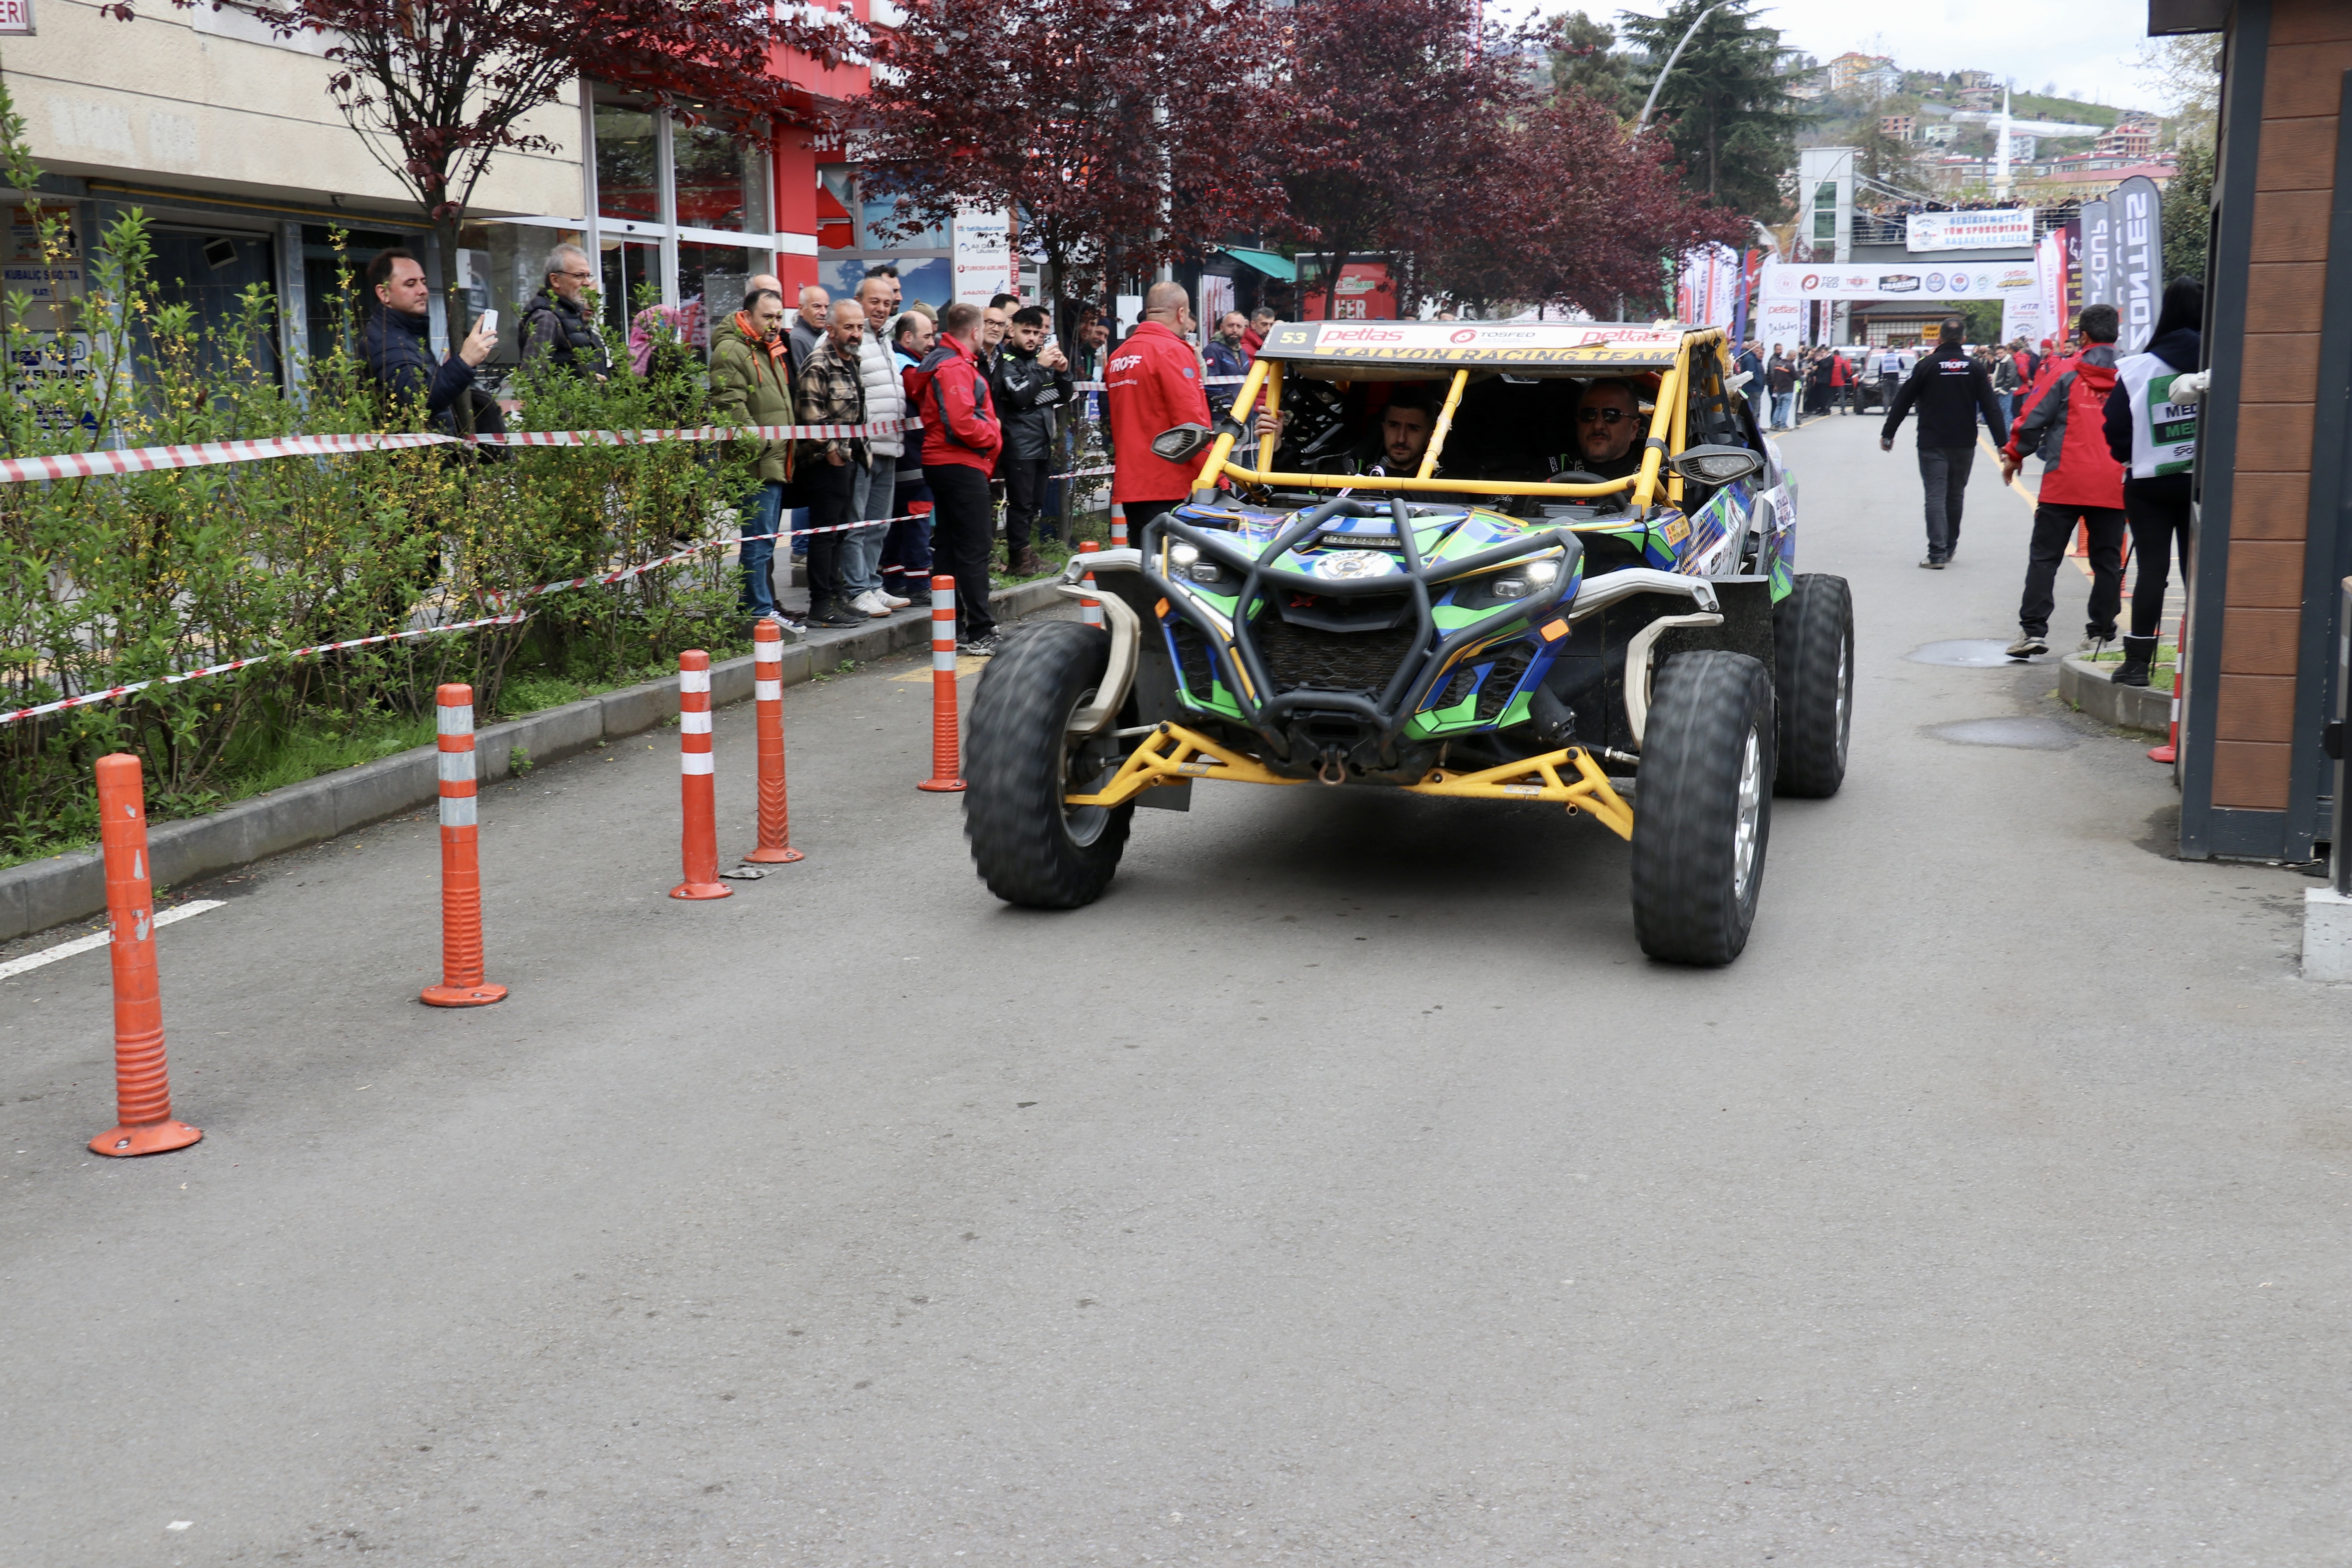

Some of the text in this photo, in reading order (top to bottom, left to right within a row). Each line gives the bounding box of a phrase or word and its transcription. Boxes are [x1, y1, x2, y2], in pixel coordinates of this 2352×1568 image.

[1944, 224, 2029, 235] TÜM SPORCULARA
[1334, 299, 1367, 319] HER
[1767, 305, 1799, 315] petlas
[1279, 332, 1308, 344] 53
[1321, 328, 1405, 343] petlas
[1333, 347, 1676, 361] KALYON RACING TEAM
[1109, 355, 1143, 373] TROFF
